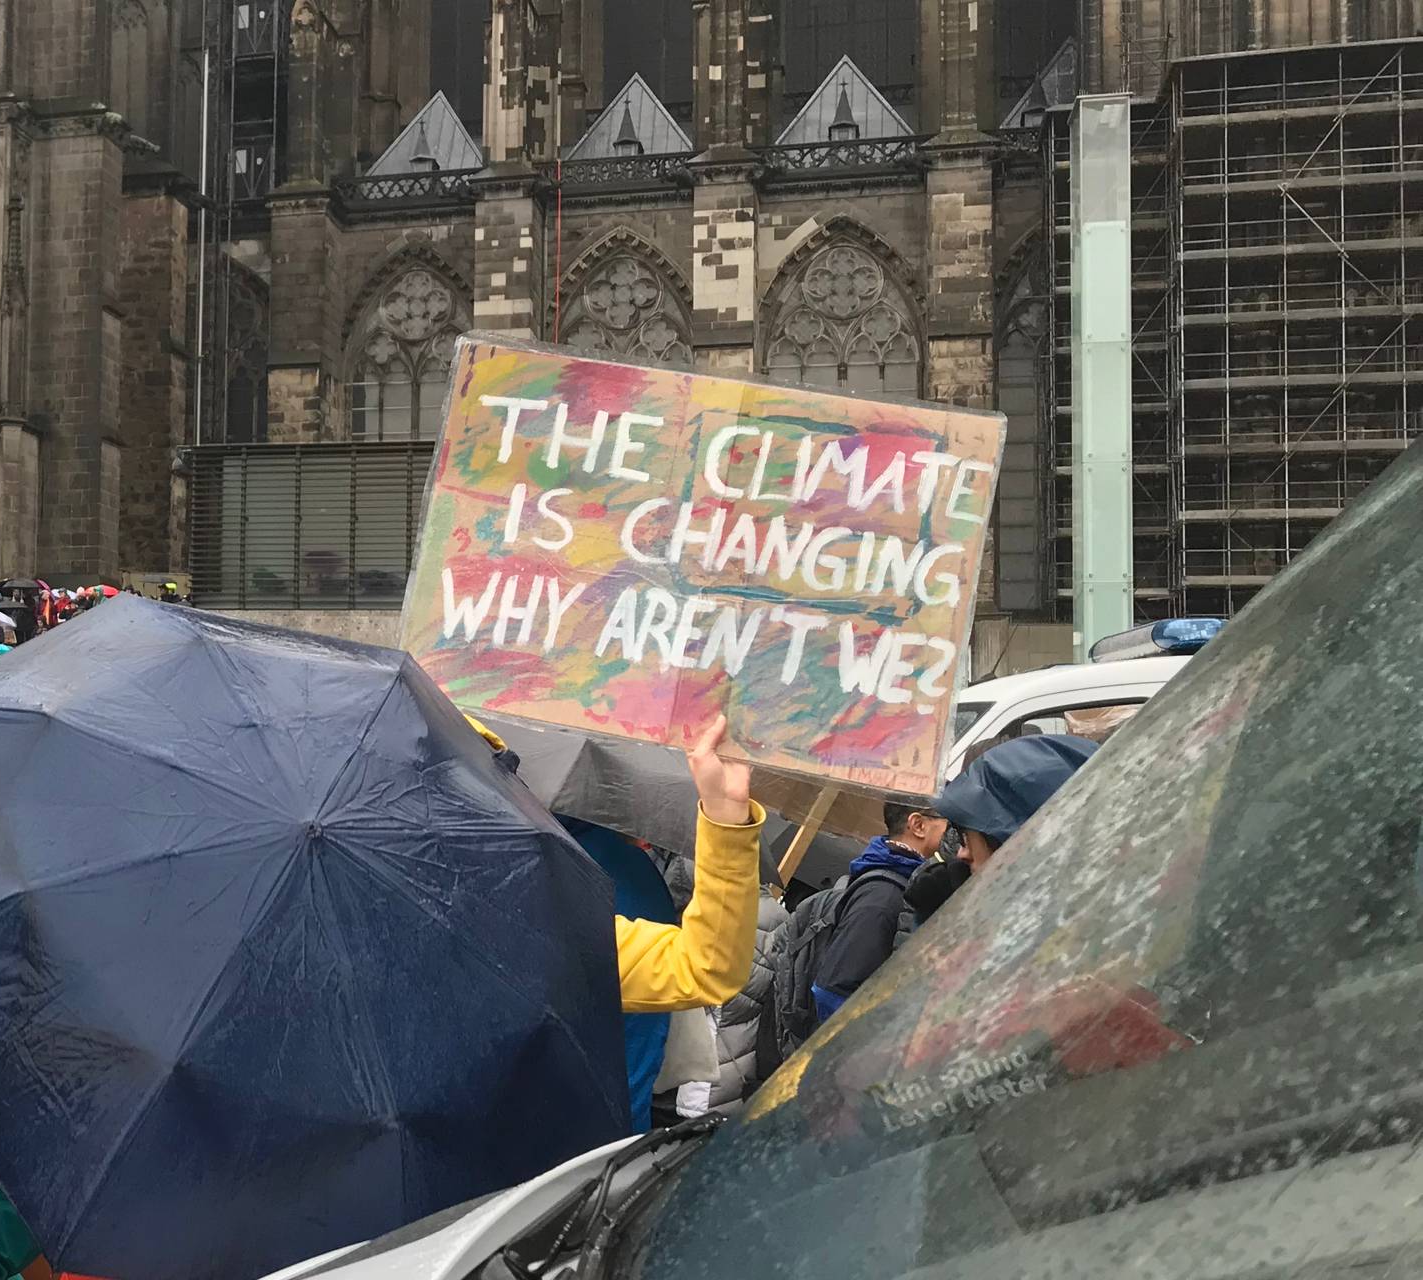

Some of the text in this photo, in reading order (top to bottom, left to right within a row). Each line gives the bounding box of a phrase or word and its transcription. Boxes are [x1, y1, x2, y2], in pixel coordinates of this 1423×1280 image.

[478, 394, 995, 525] THE CLIMATE
[503, 483, 965, 608] IS CHANGING
[441, 567, 957, 715] WHY AREN'T WE?
[882, 1072, 1048, 1132] Level Meter
[939, 1045, 1029, 1089] Sound
